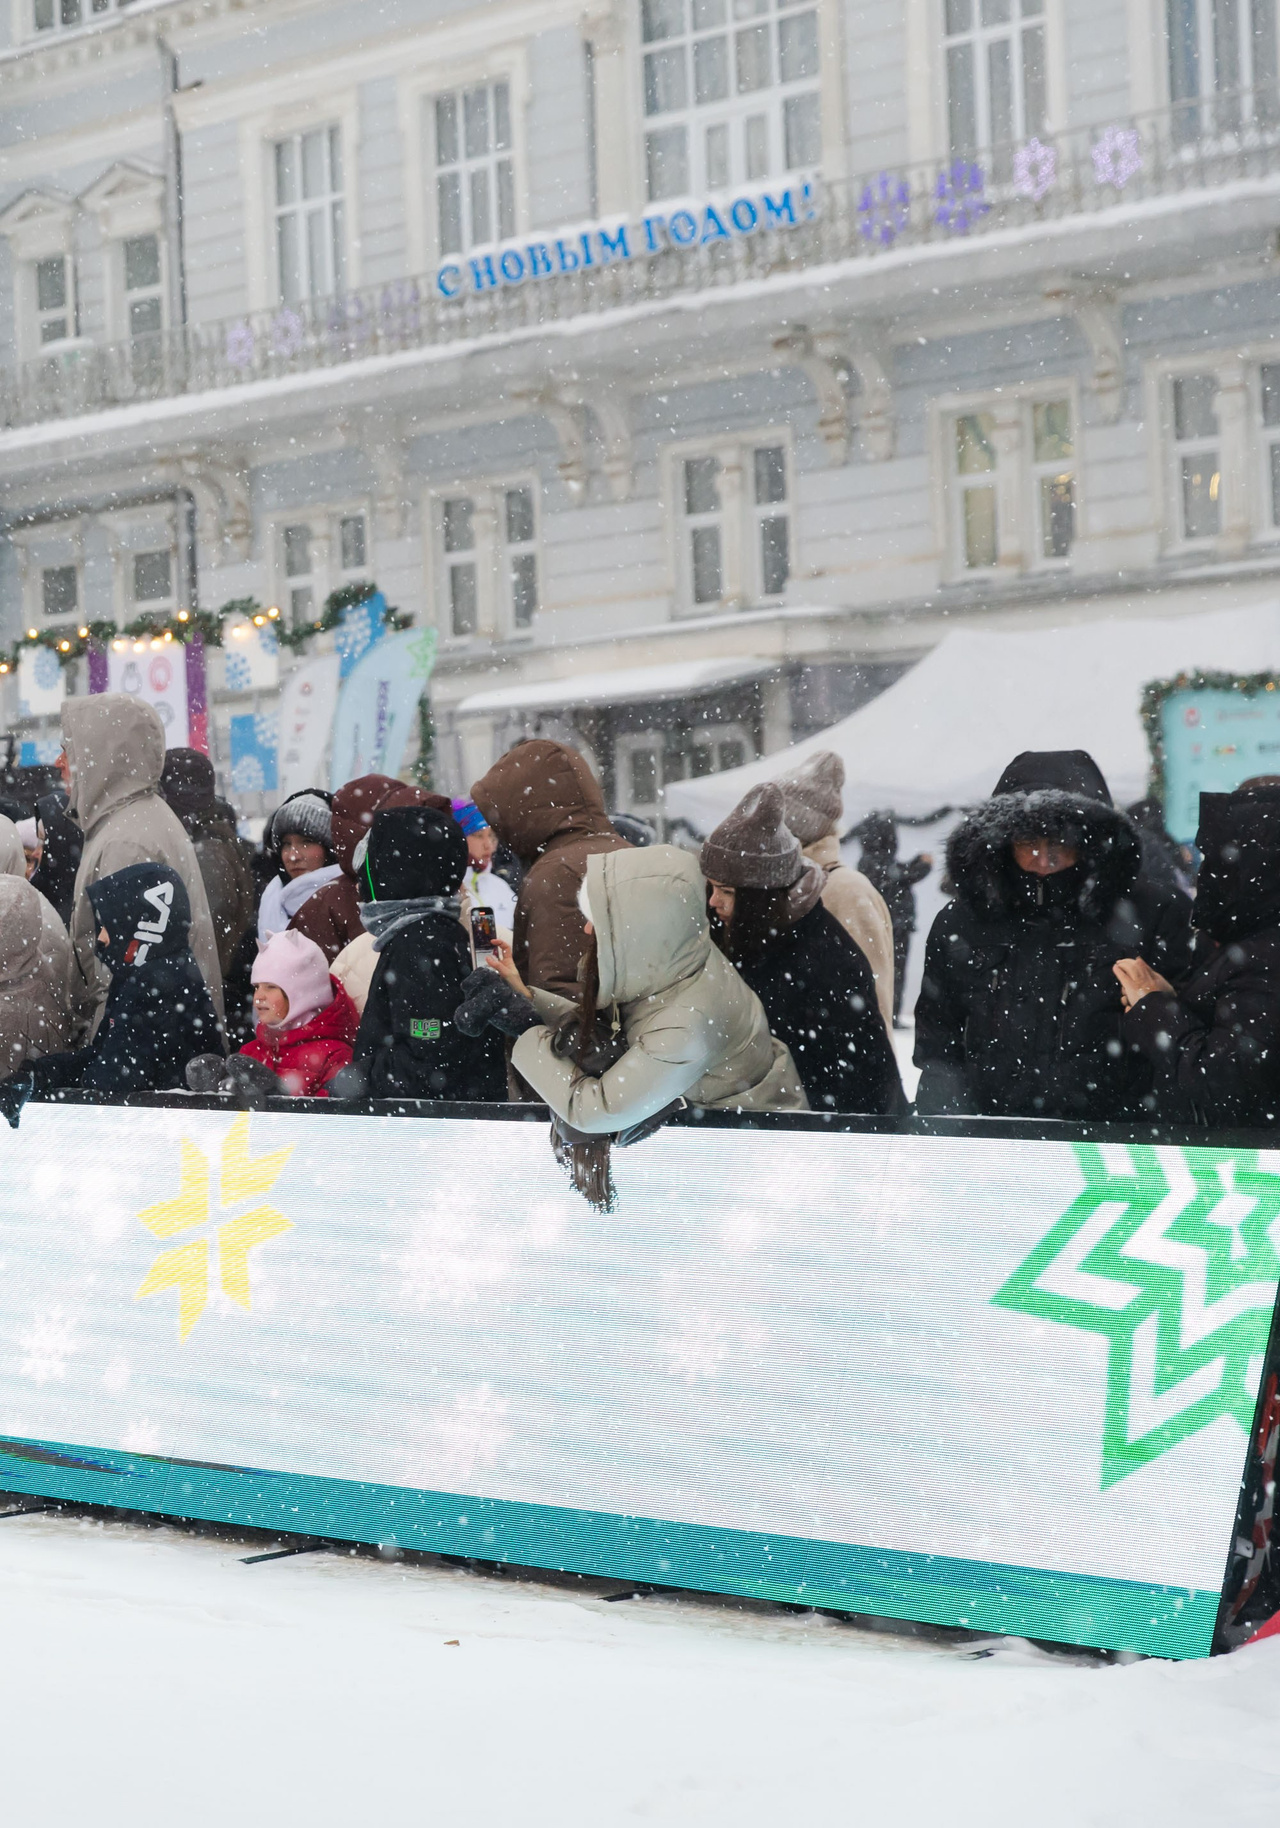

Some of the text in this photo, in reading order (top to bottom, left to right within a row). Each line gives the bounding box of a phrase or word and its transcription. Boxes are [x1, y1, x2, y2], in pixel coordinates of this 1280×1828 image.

[437, 183, 815, 296] С НОВЫМ ГОДОМ!
[124, 881, 174, 967] FILA
